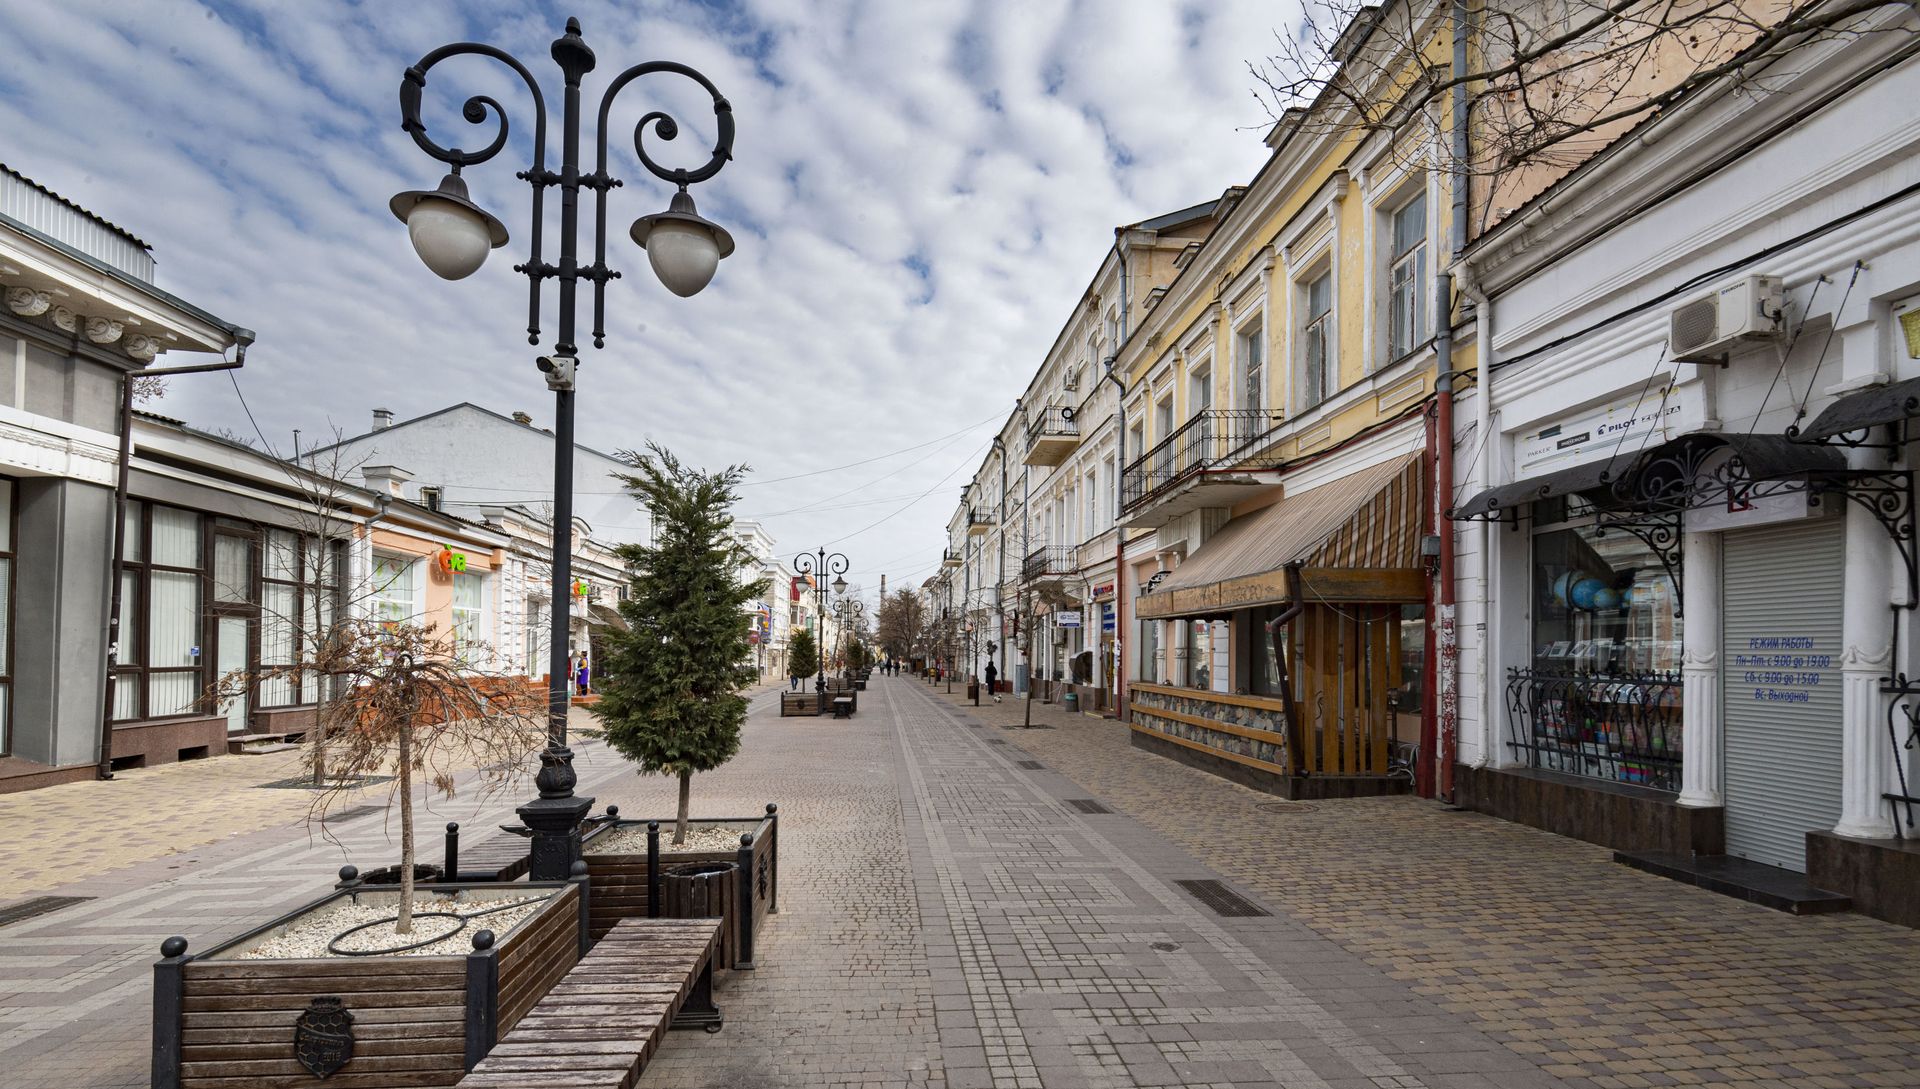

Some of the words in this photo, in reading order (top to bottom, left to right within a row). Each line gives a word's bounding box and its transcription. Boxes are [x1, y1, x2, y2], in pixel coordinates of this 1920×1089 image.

[1527, 446, 1551, 458] PARKER
[1608, 418, 1637, 433] PILOT
[1750, 636, 1779, 649] РЕЖИМ
[1781, 637, 1814, 649] РАБОТЫ
[1768, 688, 1808, 703] Выходной
